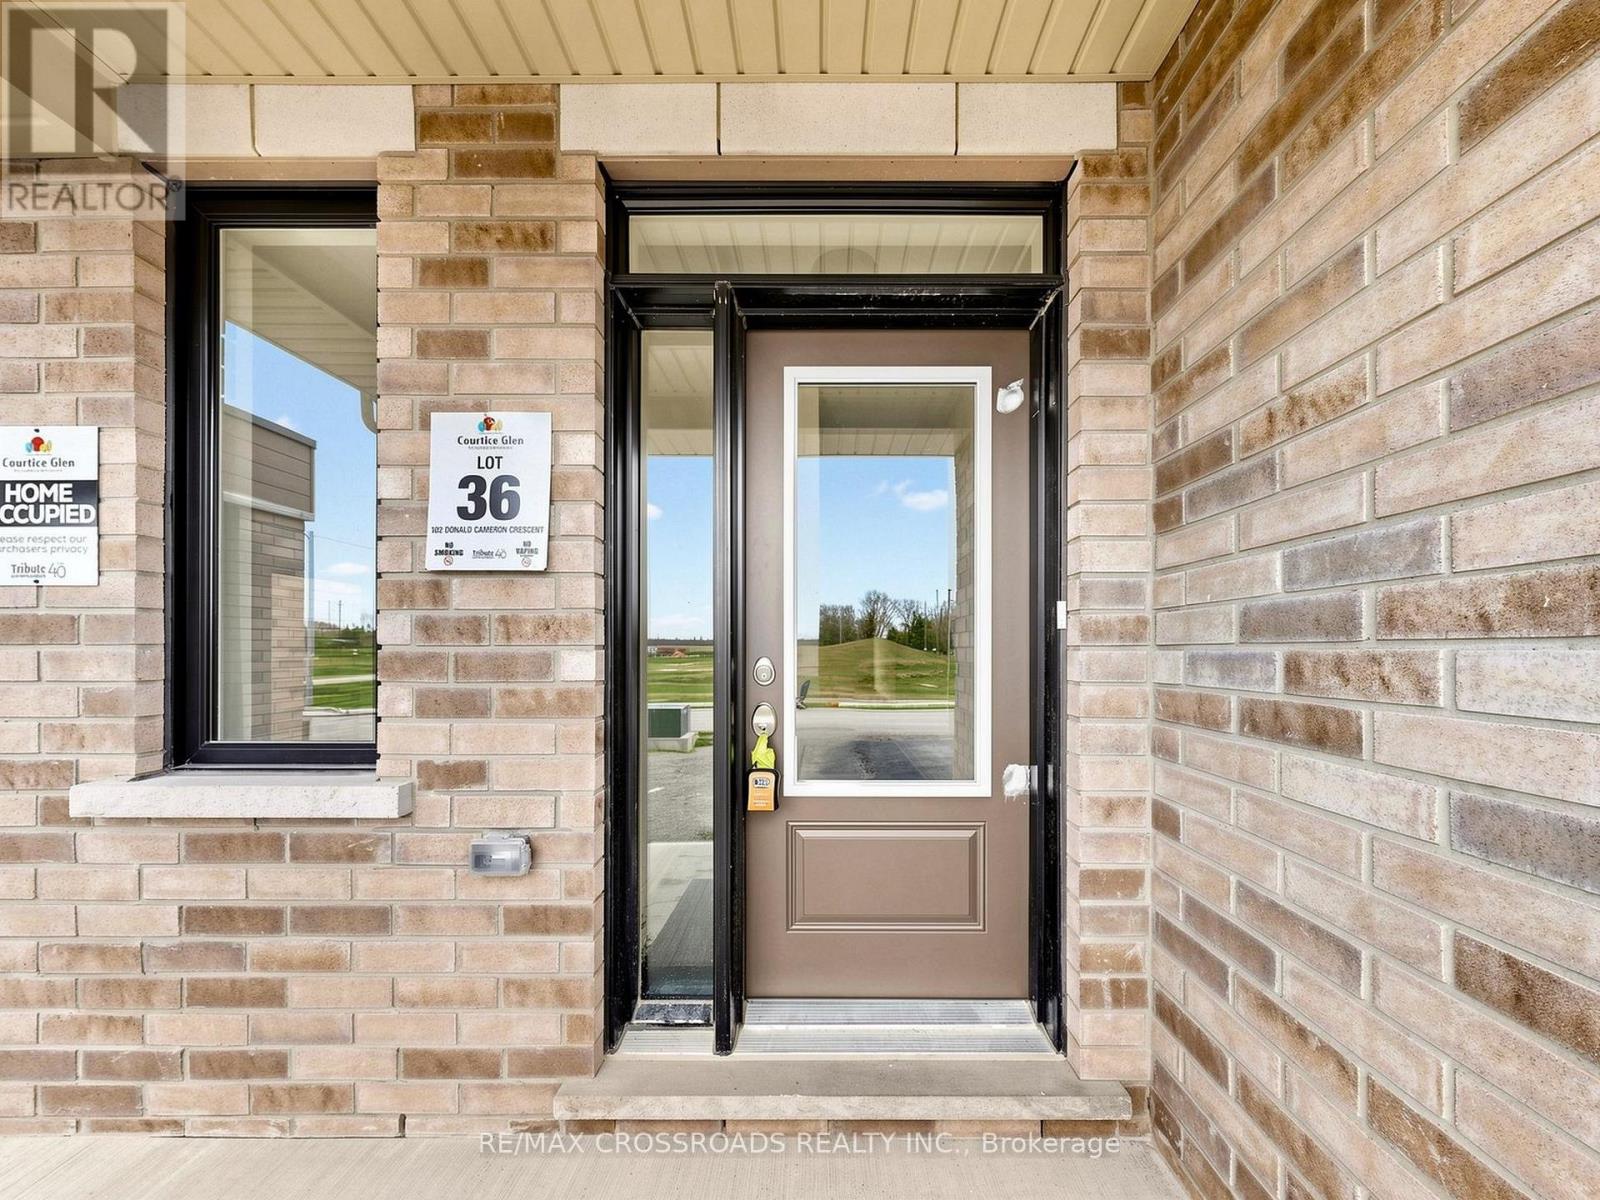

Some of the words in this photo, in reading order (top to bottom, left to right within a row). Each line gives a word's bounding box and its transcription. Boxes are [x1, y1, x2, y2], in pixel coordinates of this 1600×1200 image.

[457, 435, 499, 446] Courtice
[501, 435, 524, 446] Glen
[2, 457, 48, 468] Courtice
[50, 457, 75, 468] Glen
[477, 456, 503, 469] LOT
[5, 483, 73, 503] HOME
[456, 475, 521, 521] 36
[0, 504, 96, 524] CCUPIED
[431, 526, 443, 534] 102
[445, 526, 472, 534] DONALD
[474, 526, 507, 534] CAMERON
[509, 526, 544, 534] CRESCENT
[27, 535, 66, 545] respect
[69, 535, 87, 543] our
[0, 544, 48, 553] rchasers
[50, 544, 88, 554] privacy
[11, 563, 46, 574] Tribute
